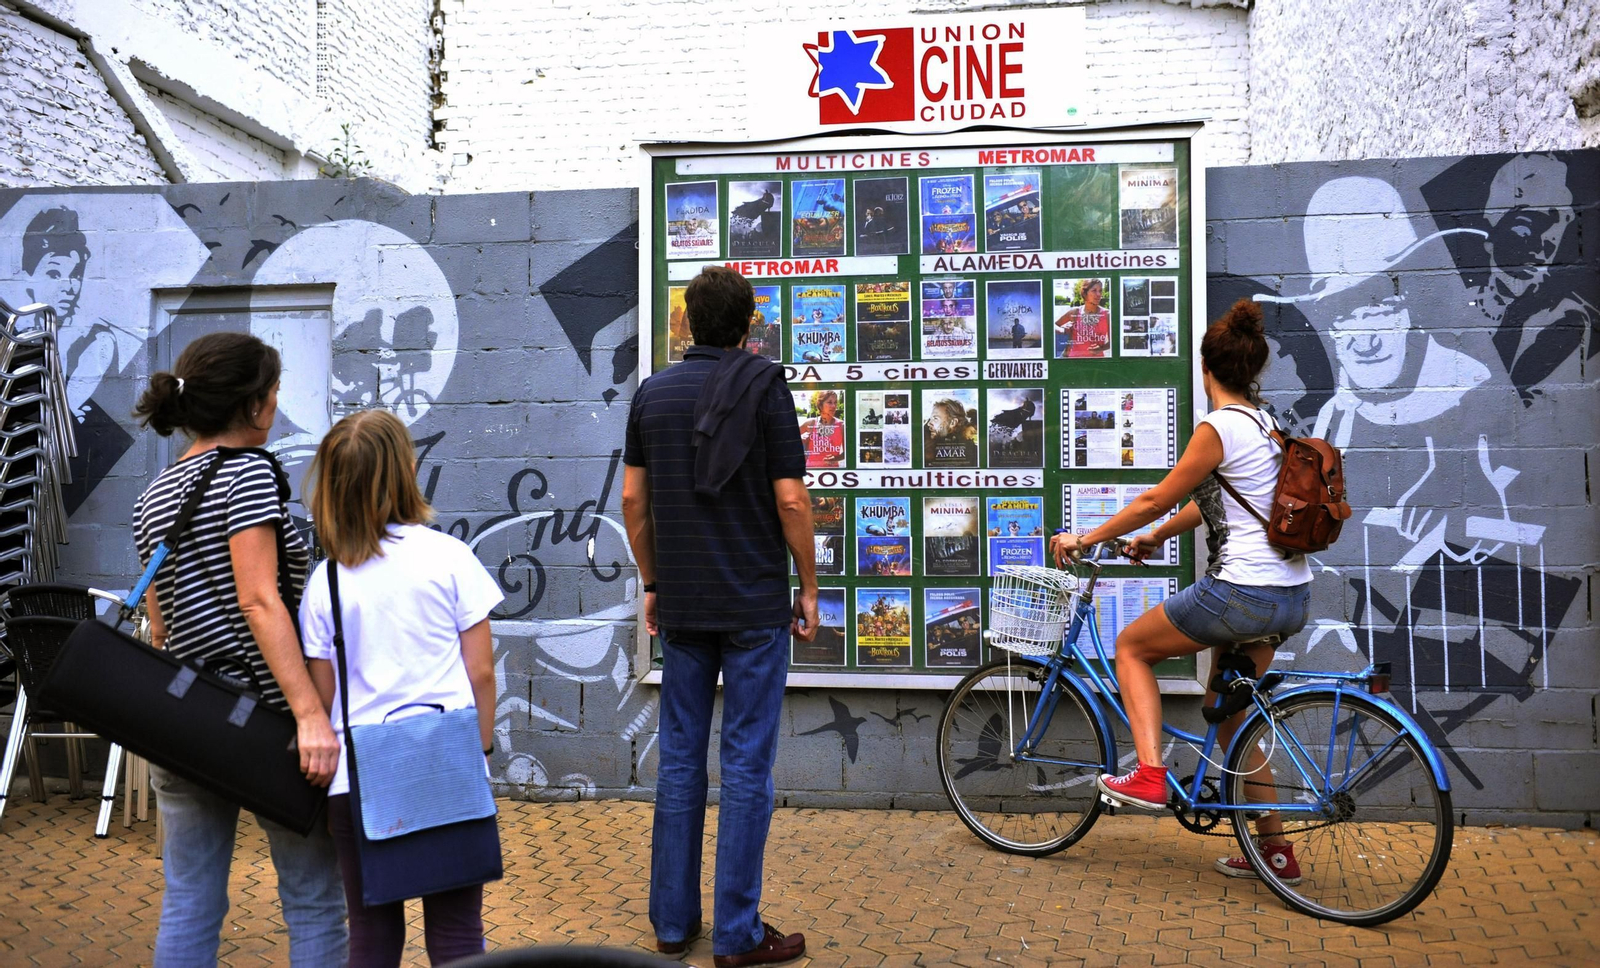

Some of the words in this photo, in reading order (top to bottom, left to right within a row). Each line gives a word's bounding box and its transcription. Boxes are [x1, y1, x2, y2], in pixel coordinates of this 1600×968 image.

[920, 22, 1025, 43] UNION
[920, 42, 1025, 103] CINE
[920, 102, 1026, 122] CIUDAD
[776, 151, 930, 171] MULTICINES
[978, 148, 1096, 165] METROMAR
[931, 186, 963, 196] FROZEN
[671, 240, 692, 248] RELATOS
[691, 239, 714, 247] SALVAJES
[725, 259, 839, 276] METROMAR
[933, 253, 1044, 272] ALAMEDA
[1056, 253, 1167, 269] multicines
[797, 332, 841, 346] KHUMBA
[926, 339, 948, 348] RELATOS
[947, 339, 971, 347] SALVAJES
[1077, 333, 1106, 342] noche
[846, 365, 864, 381] 5
[883, 364, 970, 380] cines
[988, 362, 1044, 379] CERVANTES
[813, 444, 840, 453] noche
[935, 449, 966, 458] AMAR
[880, 470, 1036, 488] multicines
[1077, 487, 1100, 495] ALAMEDA
[860, 505, 906, 519] KHUMBA
[1001, 547, 1033, 556] FROZEN
